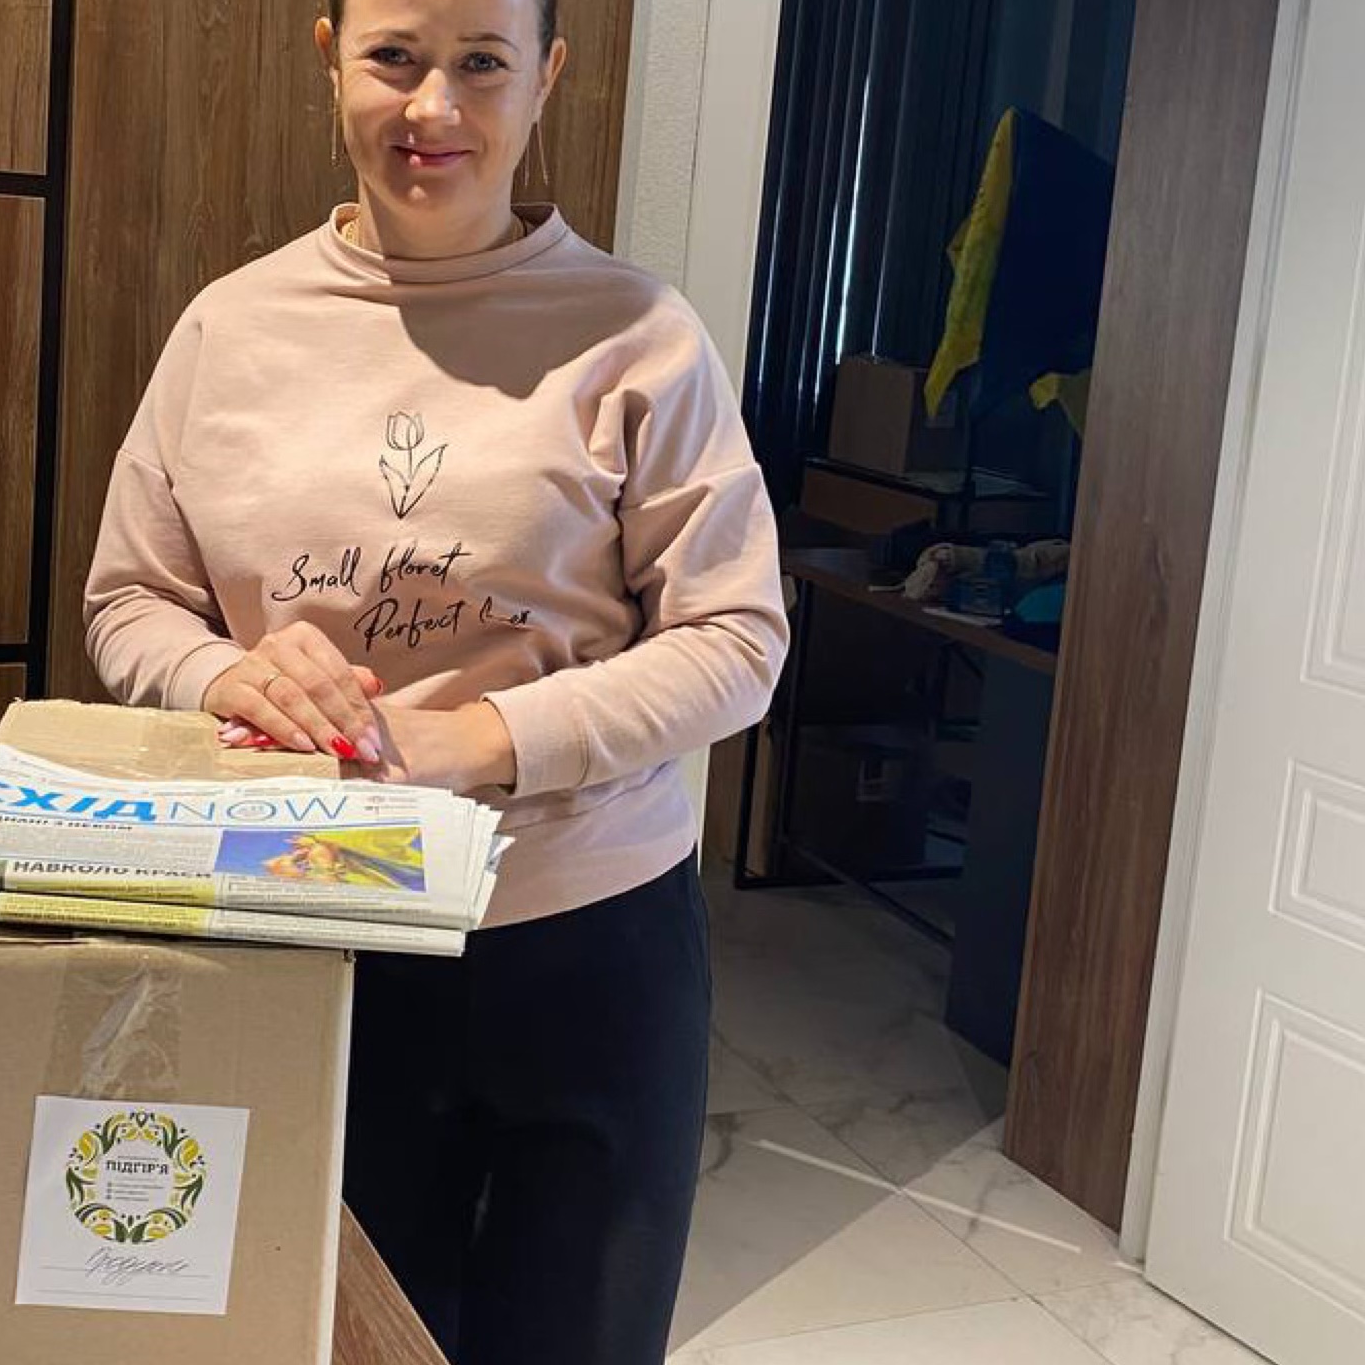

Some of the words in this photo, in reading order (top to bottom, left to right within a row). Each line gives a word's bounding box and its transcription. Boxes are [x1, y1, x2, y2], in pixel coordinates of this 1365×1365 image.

[271, 546, 361, 601] Small
[354, 597, 466, 653] Perfect
[170, 795, 348, 821] NOW
[12, 860, 130, 875] НАВКОЛО
